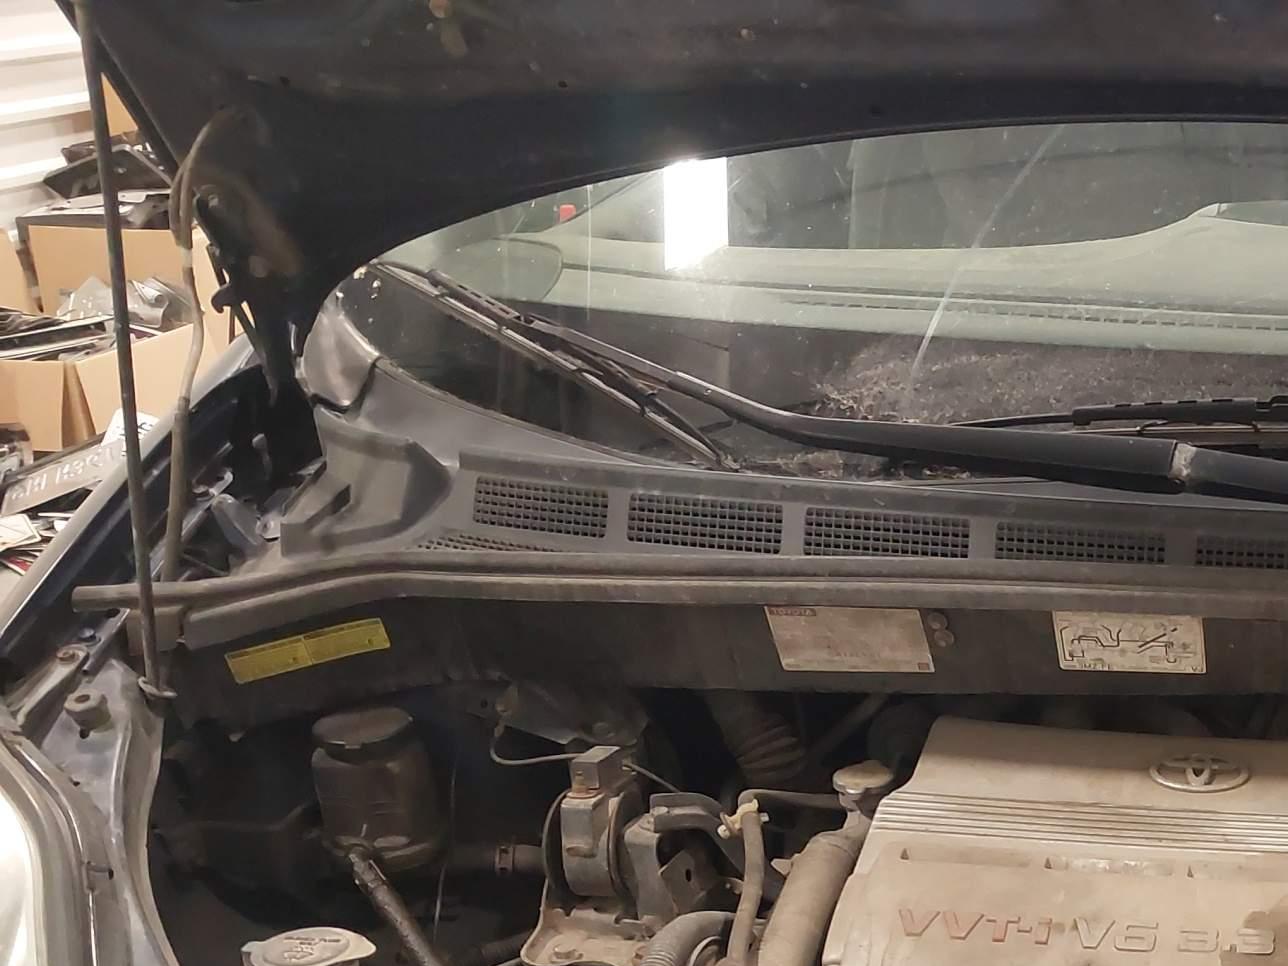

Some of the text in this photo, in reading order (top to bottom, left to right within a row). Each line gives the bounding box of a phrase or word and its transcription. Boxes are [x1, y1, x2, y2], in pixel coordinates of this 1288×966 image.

[770, 608, 813, 616] TOYOTA
[898, 908, 1276, 955] VVT-i V6 3.3
